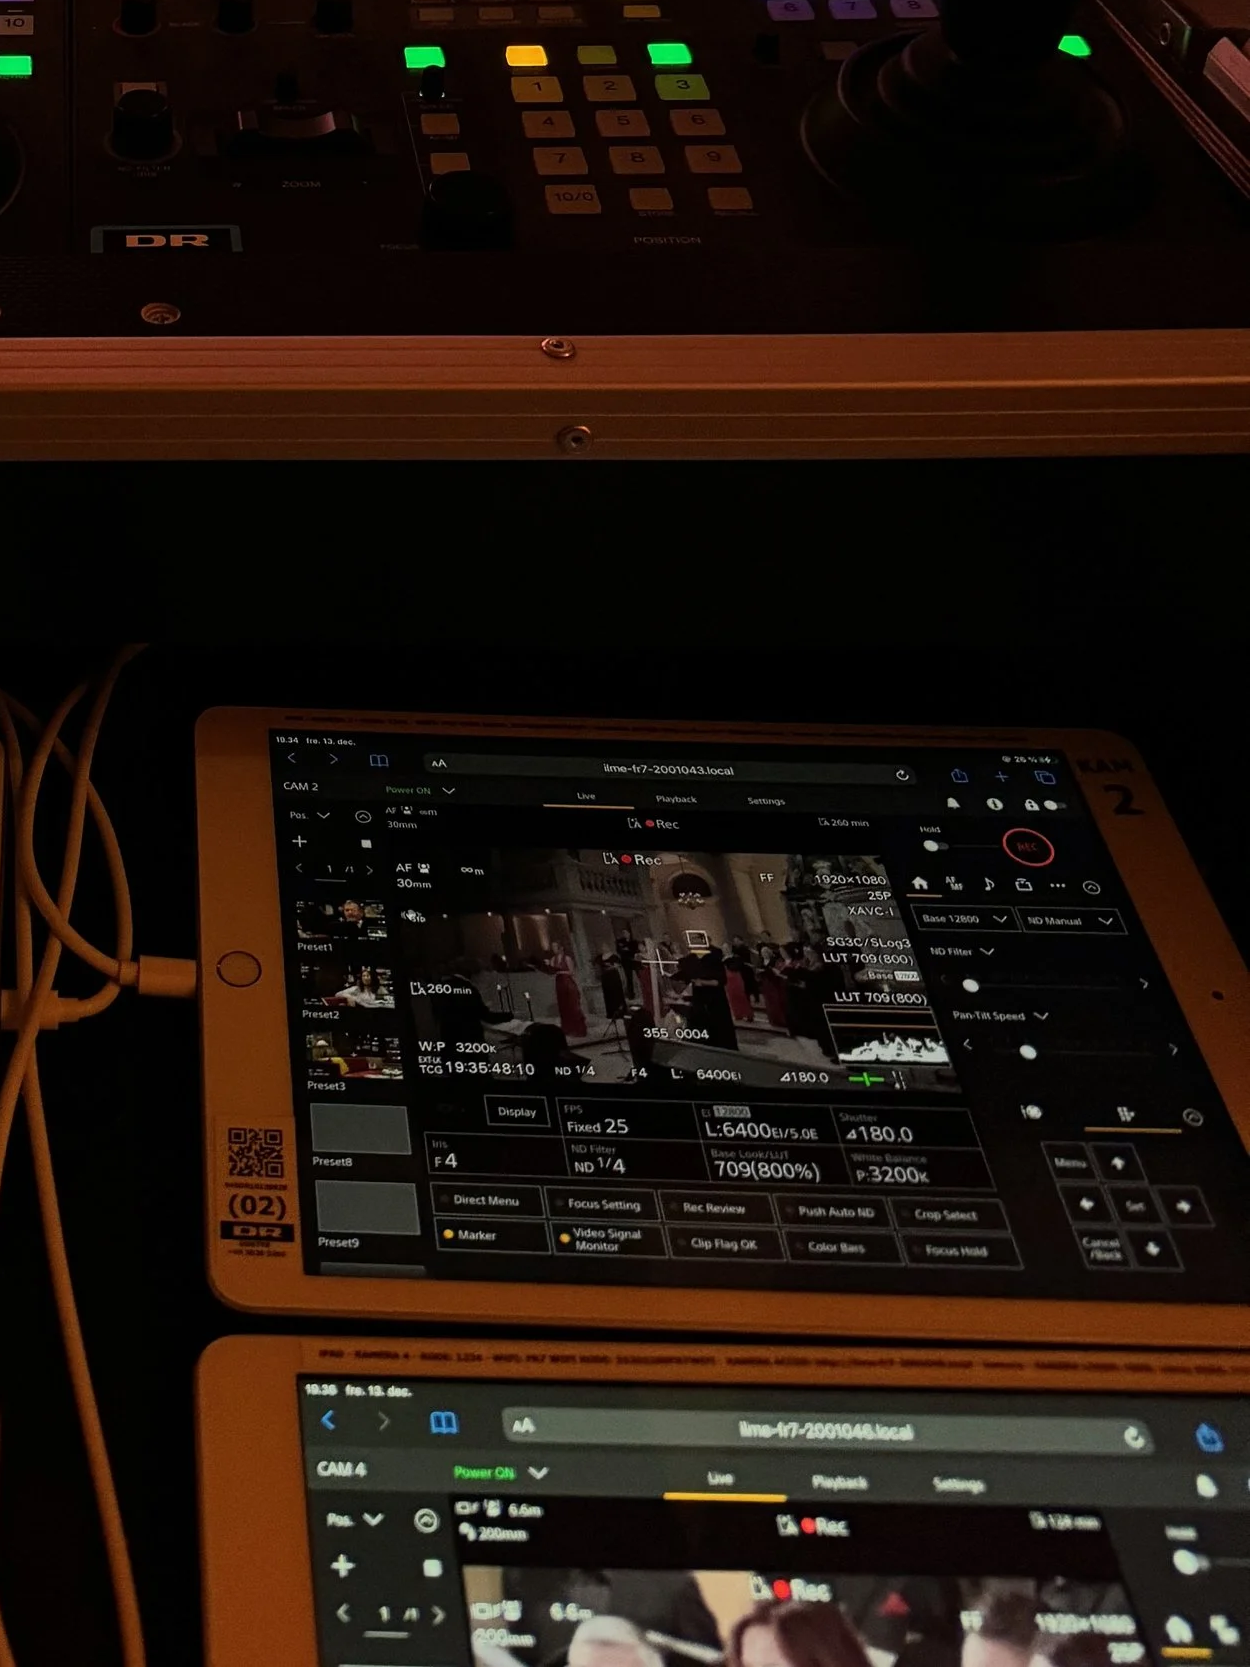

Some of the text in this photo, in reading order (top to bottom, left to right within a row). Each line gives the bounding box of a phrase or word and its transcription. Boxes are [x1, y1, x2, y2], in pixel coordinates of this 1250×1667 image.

[533, 81, 542, 91] 1
[604, 81, 617, 91] 2
[676, 80, 690, 90] 3
[542, 117, 553, 127] 4
[617, 116, 630, 126] 5
[692, 115, 705, 125] 6
[555, 153, 567, 163] 7
[631, 153, 645, 163] 8
[707, 151, 721, 162] 9
[554, 192, 594, 201] 10/0
[126, 235, 209, 247] DR
[603, 764, 734, 777] ilme-fr7-2001043.local
[283, 781, 318, 791] CAM 2
[656, 794, 697, 805] Playback
[1103, 785, 1145, 815] 2
[656, 819, 679, 830] Rec
[635, 854, 662, 866] Rec
[396, 863, 412, 873] AF
[397, 878, 432, 889] 30mm
[760, 873, 775, 882] FF
[867, 891, 891, 901] 25P
[297, 942, 333, 952] Preset1
[823, 952, 913, 966] LUT 709(800)
[835, 991, 927, 1005] LUT 709(800)
[302, 1009, 339, 1019] Preset2
[420, 1060, 535, 1075] TCG 19:35:48:10
[307, 1081, 346, 1091] Preset3
[498, 1106, 536, 1119] Display
[567, 1119, 628, 1134] Fixed 25
[715, 1161, 820, 1181] 709(800%)
[454, 1194, 519, 1206] Direct Menu
[568, 1199, 640, 1213] Focus Setting
[229, 1194, 286, 1220] (02)
[799, 1205, 874, 1217] Push Auto ND
[458, 1229, 496, 1241] Marker
[318, 1237, 359, 1249] Preset9
[809, 1242, 865, 1253] Color Bars
[317, 1461, 366, 1477] CAM 4
[454, 1467, 515, 1479] Power ON
[708, 1472, 733, 1485] Live
[812, 1474, 868, 1490] Playback
[933, 1476, 985, 1493] Settings
[791, 1579, 831, 1602] Rec
